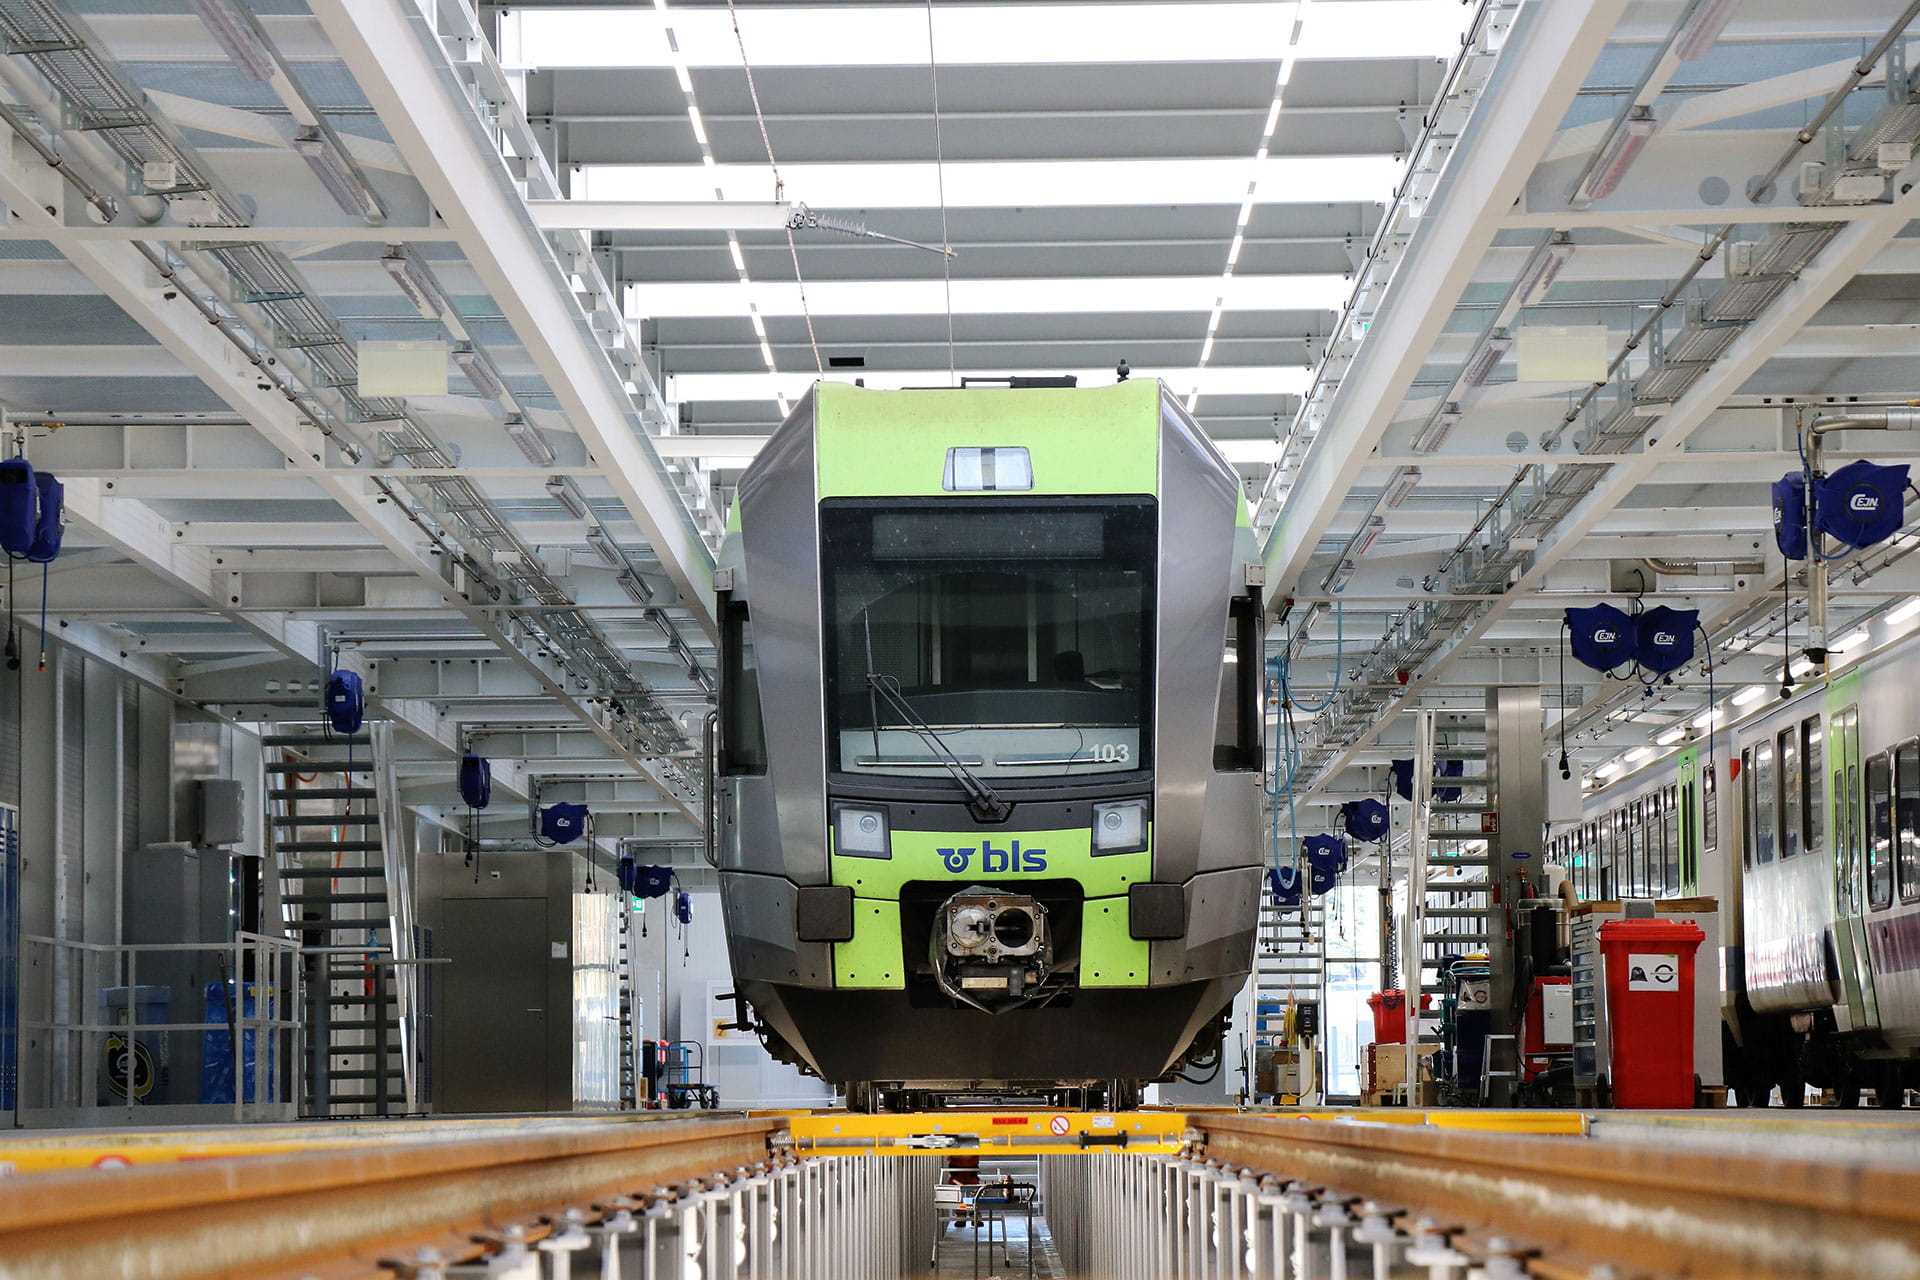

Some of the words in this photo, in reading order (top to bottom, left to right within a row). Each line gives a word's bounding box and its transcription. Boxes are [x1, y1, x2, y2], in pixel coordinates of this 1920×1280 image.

[1850, 493, 1879, 510] CEJN
[1594, 629, 1616, 643] CEJN
[1653, 632, 1676, 645] CEJN
[1090, 743, 1129, 762] 103
[982, 840, 1047, 872] bls
